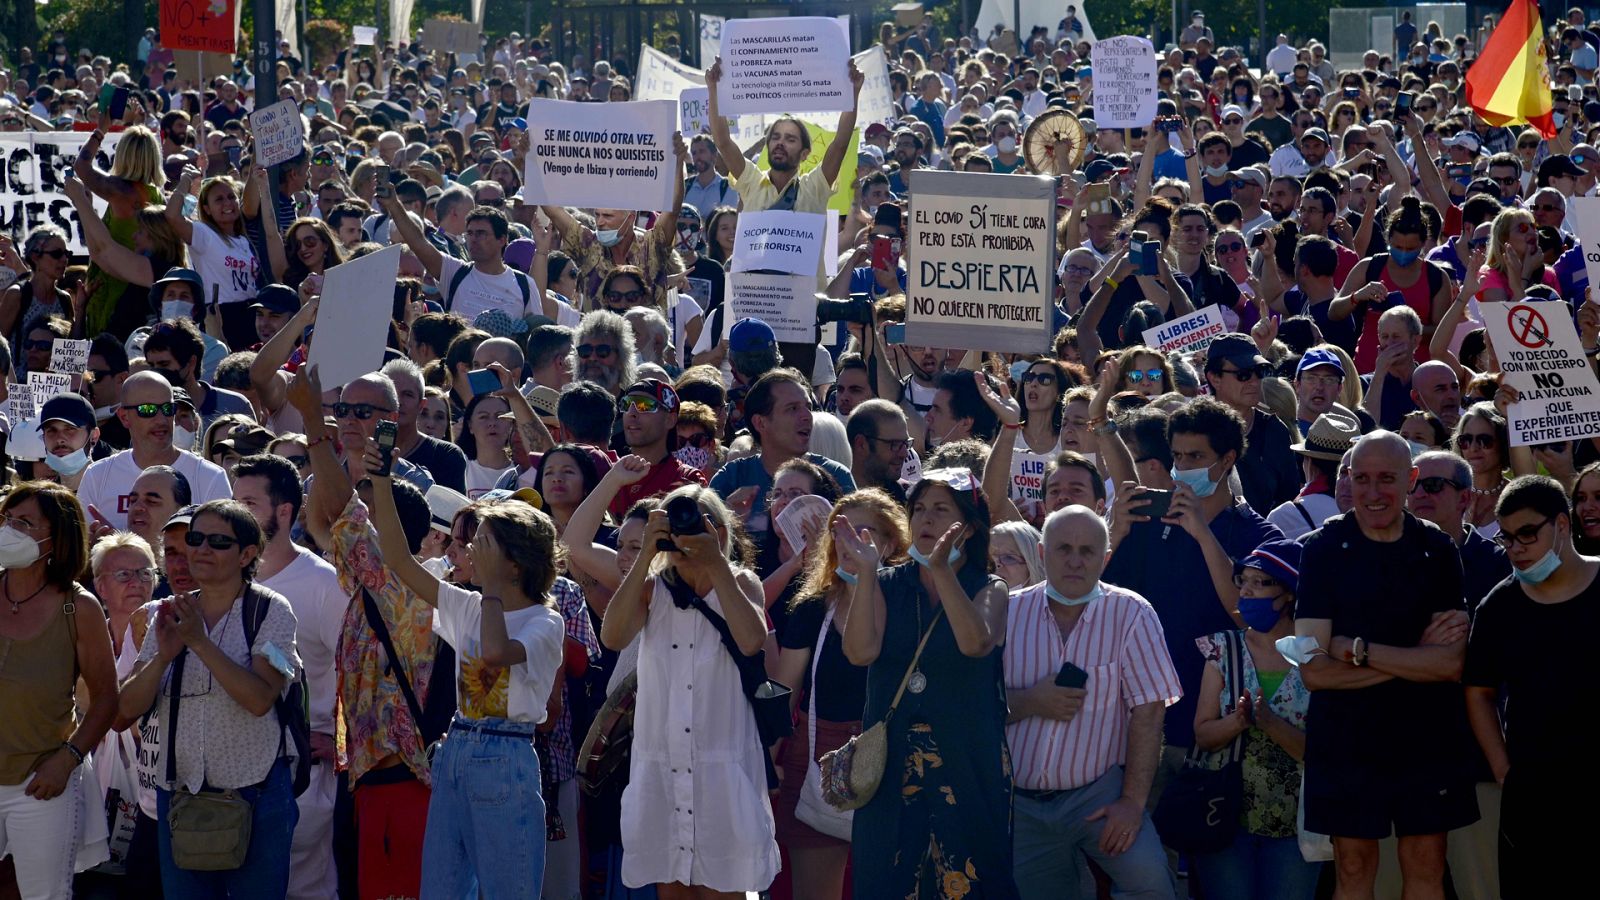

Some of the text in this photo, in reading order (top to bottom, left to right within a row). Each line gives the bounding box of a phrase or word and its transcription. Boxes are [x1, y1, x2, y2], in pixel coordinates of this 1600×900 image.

[742, 36, 790, 44] MASCARILLAS
[1095, 40, 1128, 49] NO NOS
[738, 47, 799, 55] CONFINAMIENTO
[1126, 58, 1135, 67] DE
[683, 100, 702, 118] PCR
[544, 129, 657, 148] SE ME OLVIDÓ OTRA VEZ,
[537, 145, 664, 162] QUE NUNCA NOS QUISISTEIS
[544, 161, 658, 180] (Vengo de Ibiza y corriendo)
[916, 210, 929, 224] EL
[970, 204, 988, 229] SÍ
[1023, 216, 1046, 230] CURA
[743, 227, 814, 240] SICOPLANDEMIA
[920, 232, 945, 246] PERO
[951, 232, 976, 248] ESTÁ
[750, 242, 802, 254] TERRORISTA
[913, 296, 934, 315] NO
[988, 304, 1043, 322] PROTEGERTE
[1157, 313, 1210, 345] ¡LIBRES!
[64, 341, 76, 349] LOS
[1509, 349, 1568, 362] YO DECIDO
[1502, 359, 1586, 373] CON MI CUERPO
[32, 374, 70, 386] EL MIEDO
[1532, 372, 1564, 389] NO
[1518, 386, 1592, 401] A LA VACUNA
[1545, 401, 1574, 416] ¡QUE
[1522, 428, 1562, 442] ENTRE
[1018, 488, 1024, 497] Y
